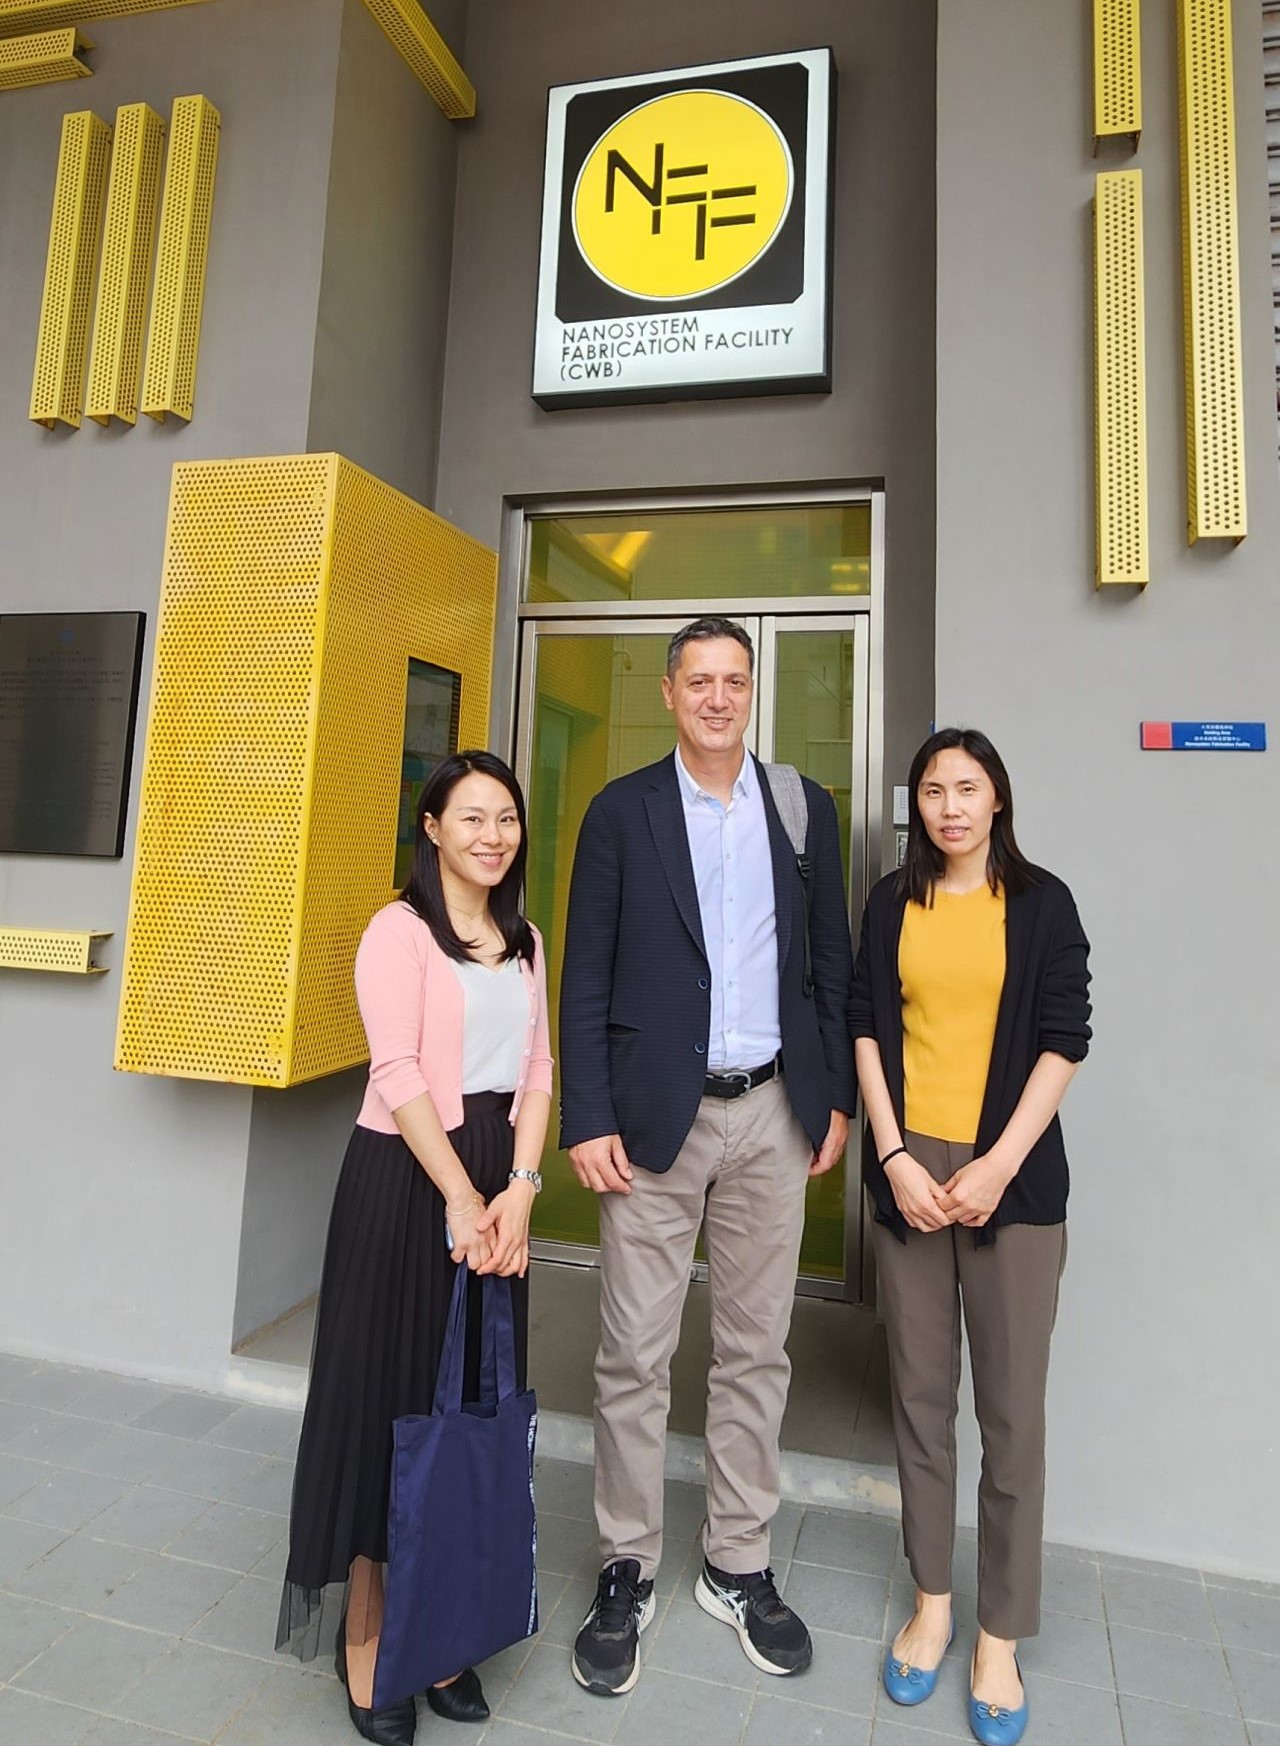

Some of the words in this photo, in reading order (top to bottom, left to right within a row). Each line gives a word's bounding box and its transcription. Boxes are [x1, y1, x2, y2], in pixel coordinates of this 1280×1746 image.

[562, 316, 700, 344] NANOSYSTEM
[561, 335, 697, 363] FABRICATION
[704, 327, 794, 351] FACILITY
[560, 360, 623, 382] (CWB)
